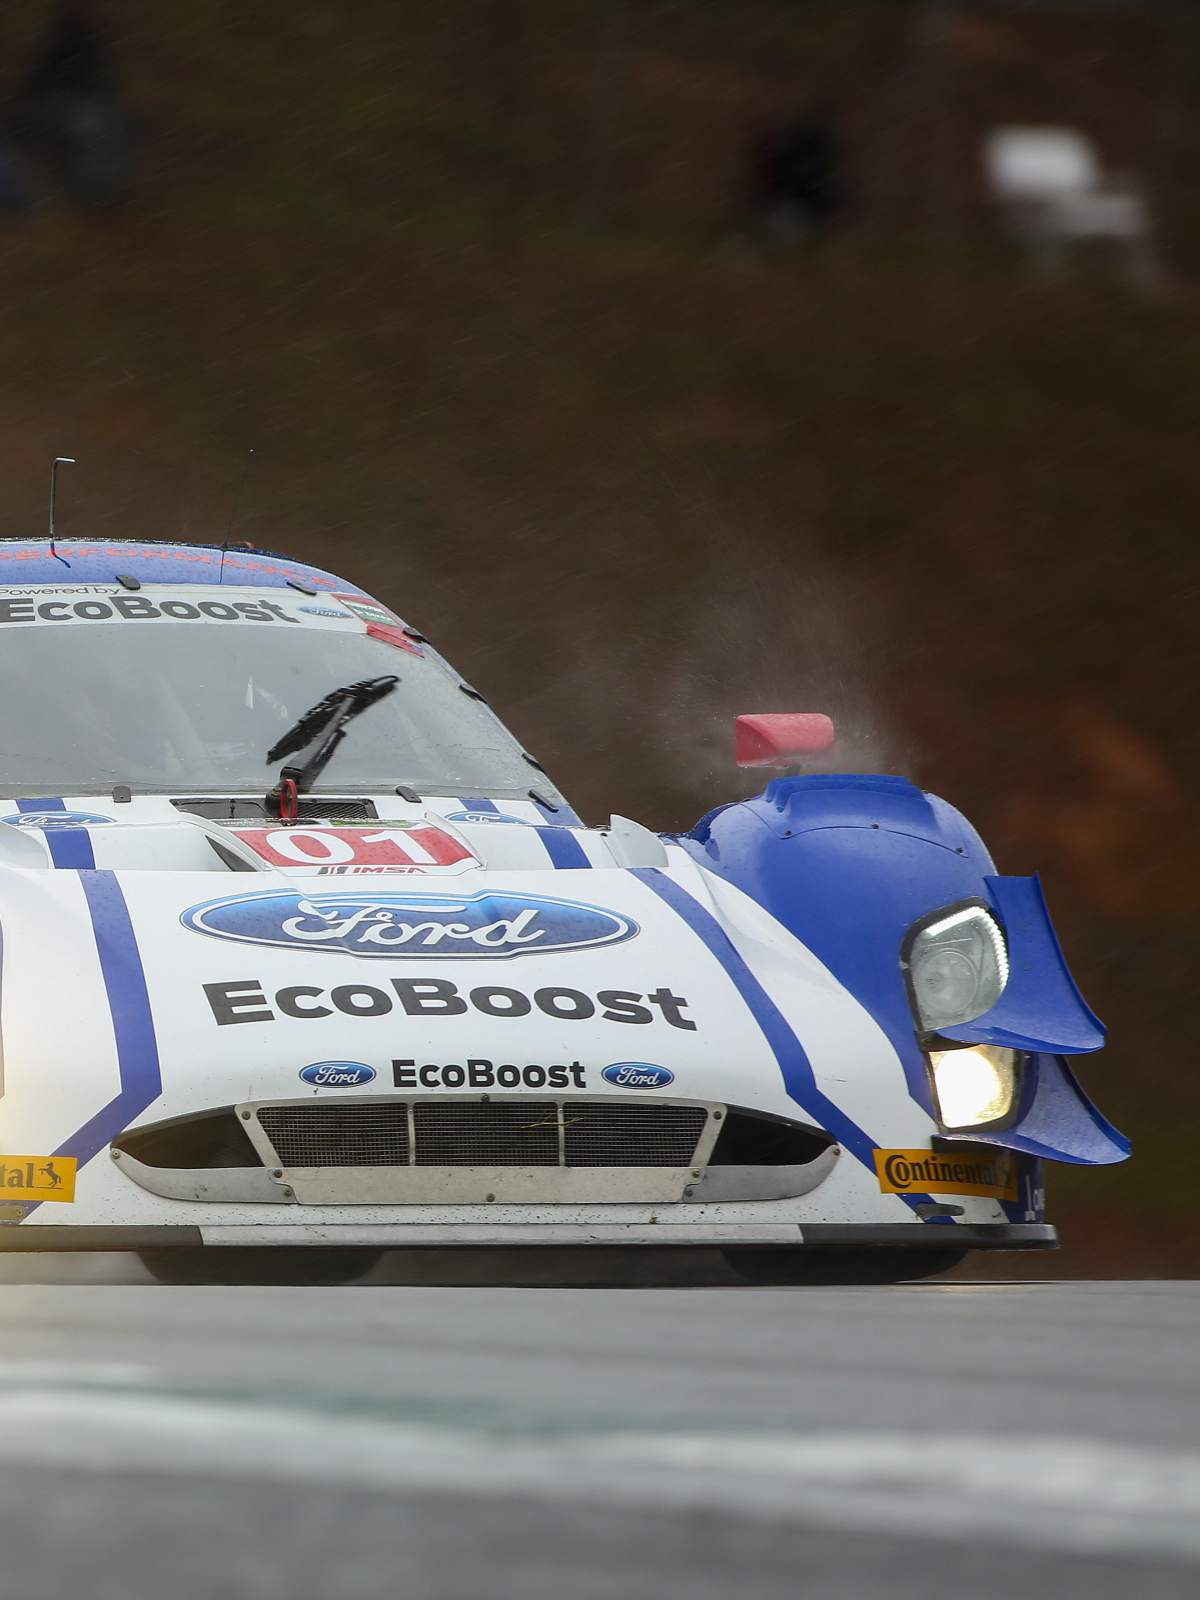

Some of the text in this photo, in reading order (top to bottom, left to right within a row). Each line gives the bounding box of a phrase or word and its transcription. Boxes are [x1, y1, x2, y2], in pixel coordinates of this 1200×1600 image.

[93, 586, 121, 596] by
[264, 828, 439, 866] 01
[281, 899, 546, 947] Ford
[201, 978, 699, 1032] EcoBoost
[391, 1058, 587, 1089] EcoBoost
